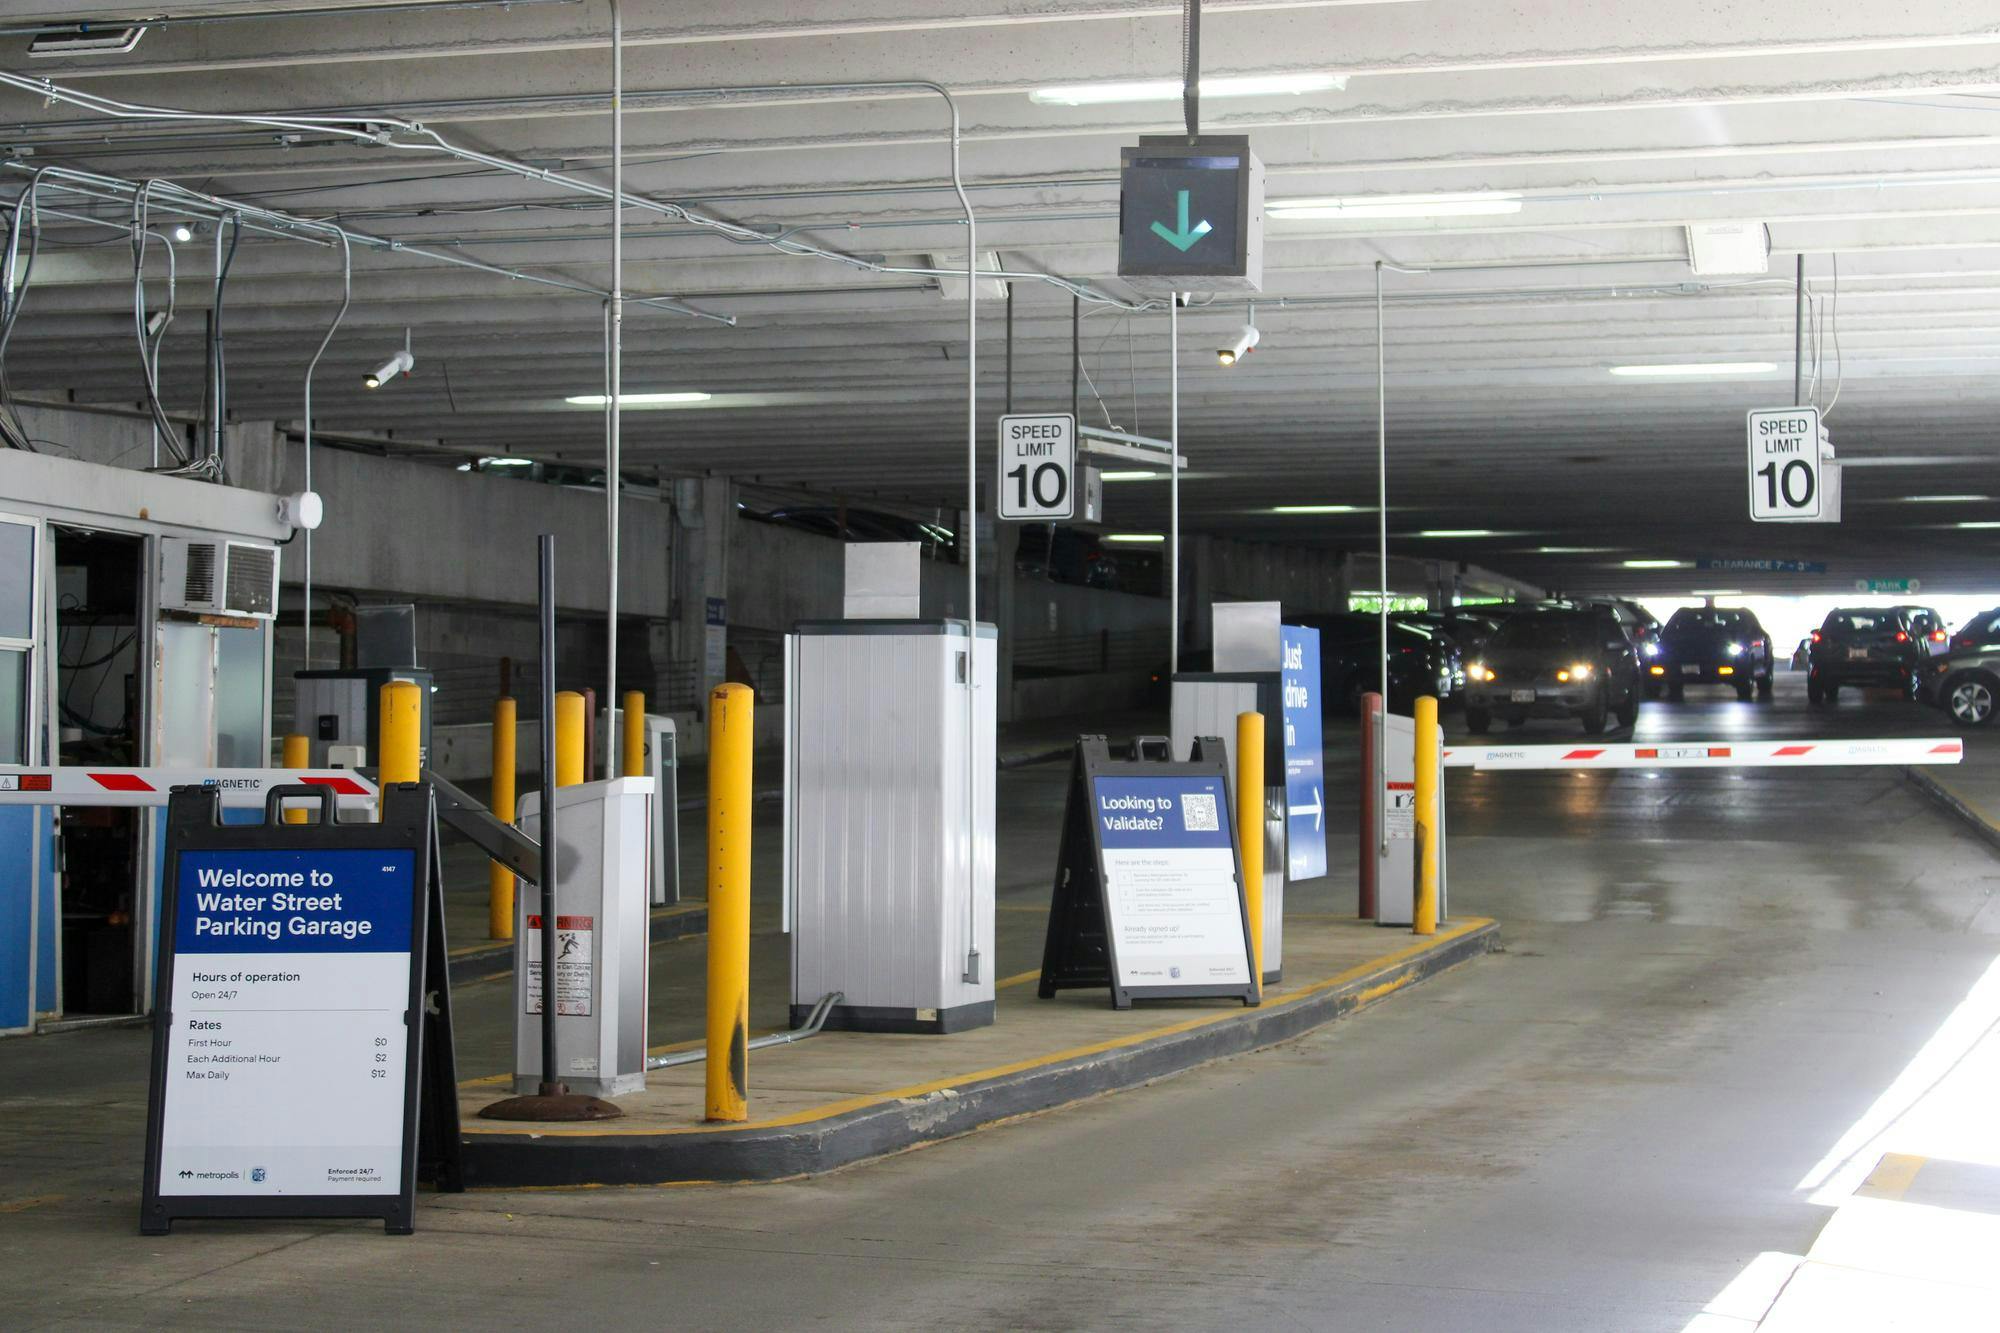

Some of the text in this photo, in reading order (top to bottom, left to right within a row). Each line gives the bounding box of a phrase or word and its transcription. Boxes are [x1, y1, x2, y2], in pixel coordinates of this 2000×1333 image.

[1011, 425, 1062, 439] SPEED
[1759, 419, 1808, 435] SPEED
[1017, 442, 1056, 457] LIMIT
[1765, 438, 1802, 454] LIMIT
[1007, 462, 1068, 508] 10
[1757, 459, 1815, 508] 10
[1711, 560, 1772, 570] CLEARANCE
[1875, 581, 1901, 592] PARK
[1283, 640, 1303, 670] Just
[1285, 679, 1308, 708] drive
[1286, 718, 1296, 746] in
[1102, 796, 1172, 813] Looking to
[1104, 817, 1164, 830] Validate?
[198, 869, 334, 888] Welcome to
[196, 892, 342, 911] Water Street
[195, 916, 372, 940] Parking Garage
[193, 972, 301, 984] Hours of operation
[191, 990, 238, 1000] Open 24/7
[189, 1020, 222, 1030] Rates
[188, 1037, 388, 1047] First Hour $0
[187, 1053, 387, 1063] Each Additional Hour $2
[186, 1069, 386, 1081] Max Daily $12
[196, 1171, 239, 1181] metropolis
